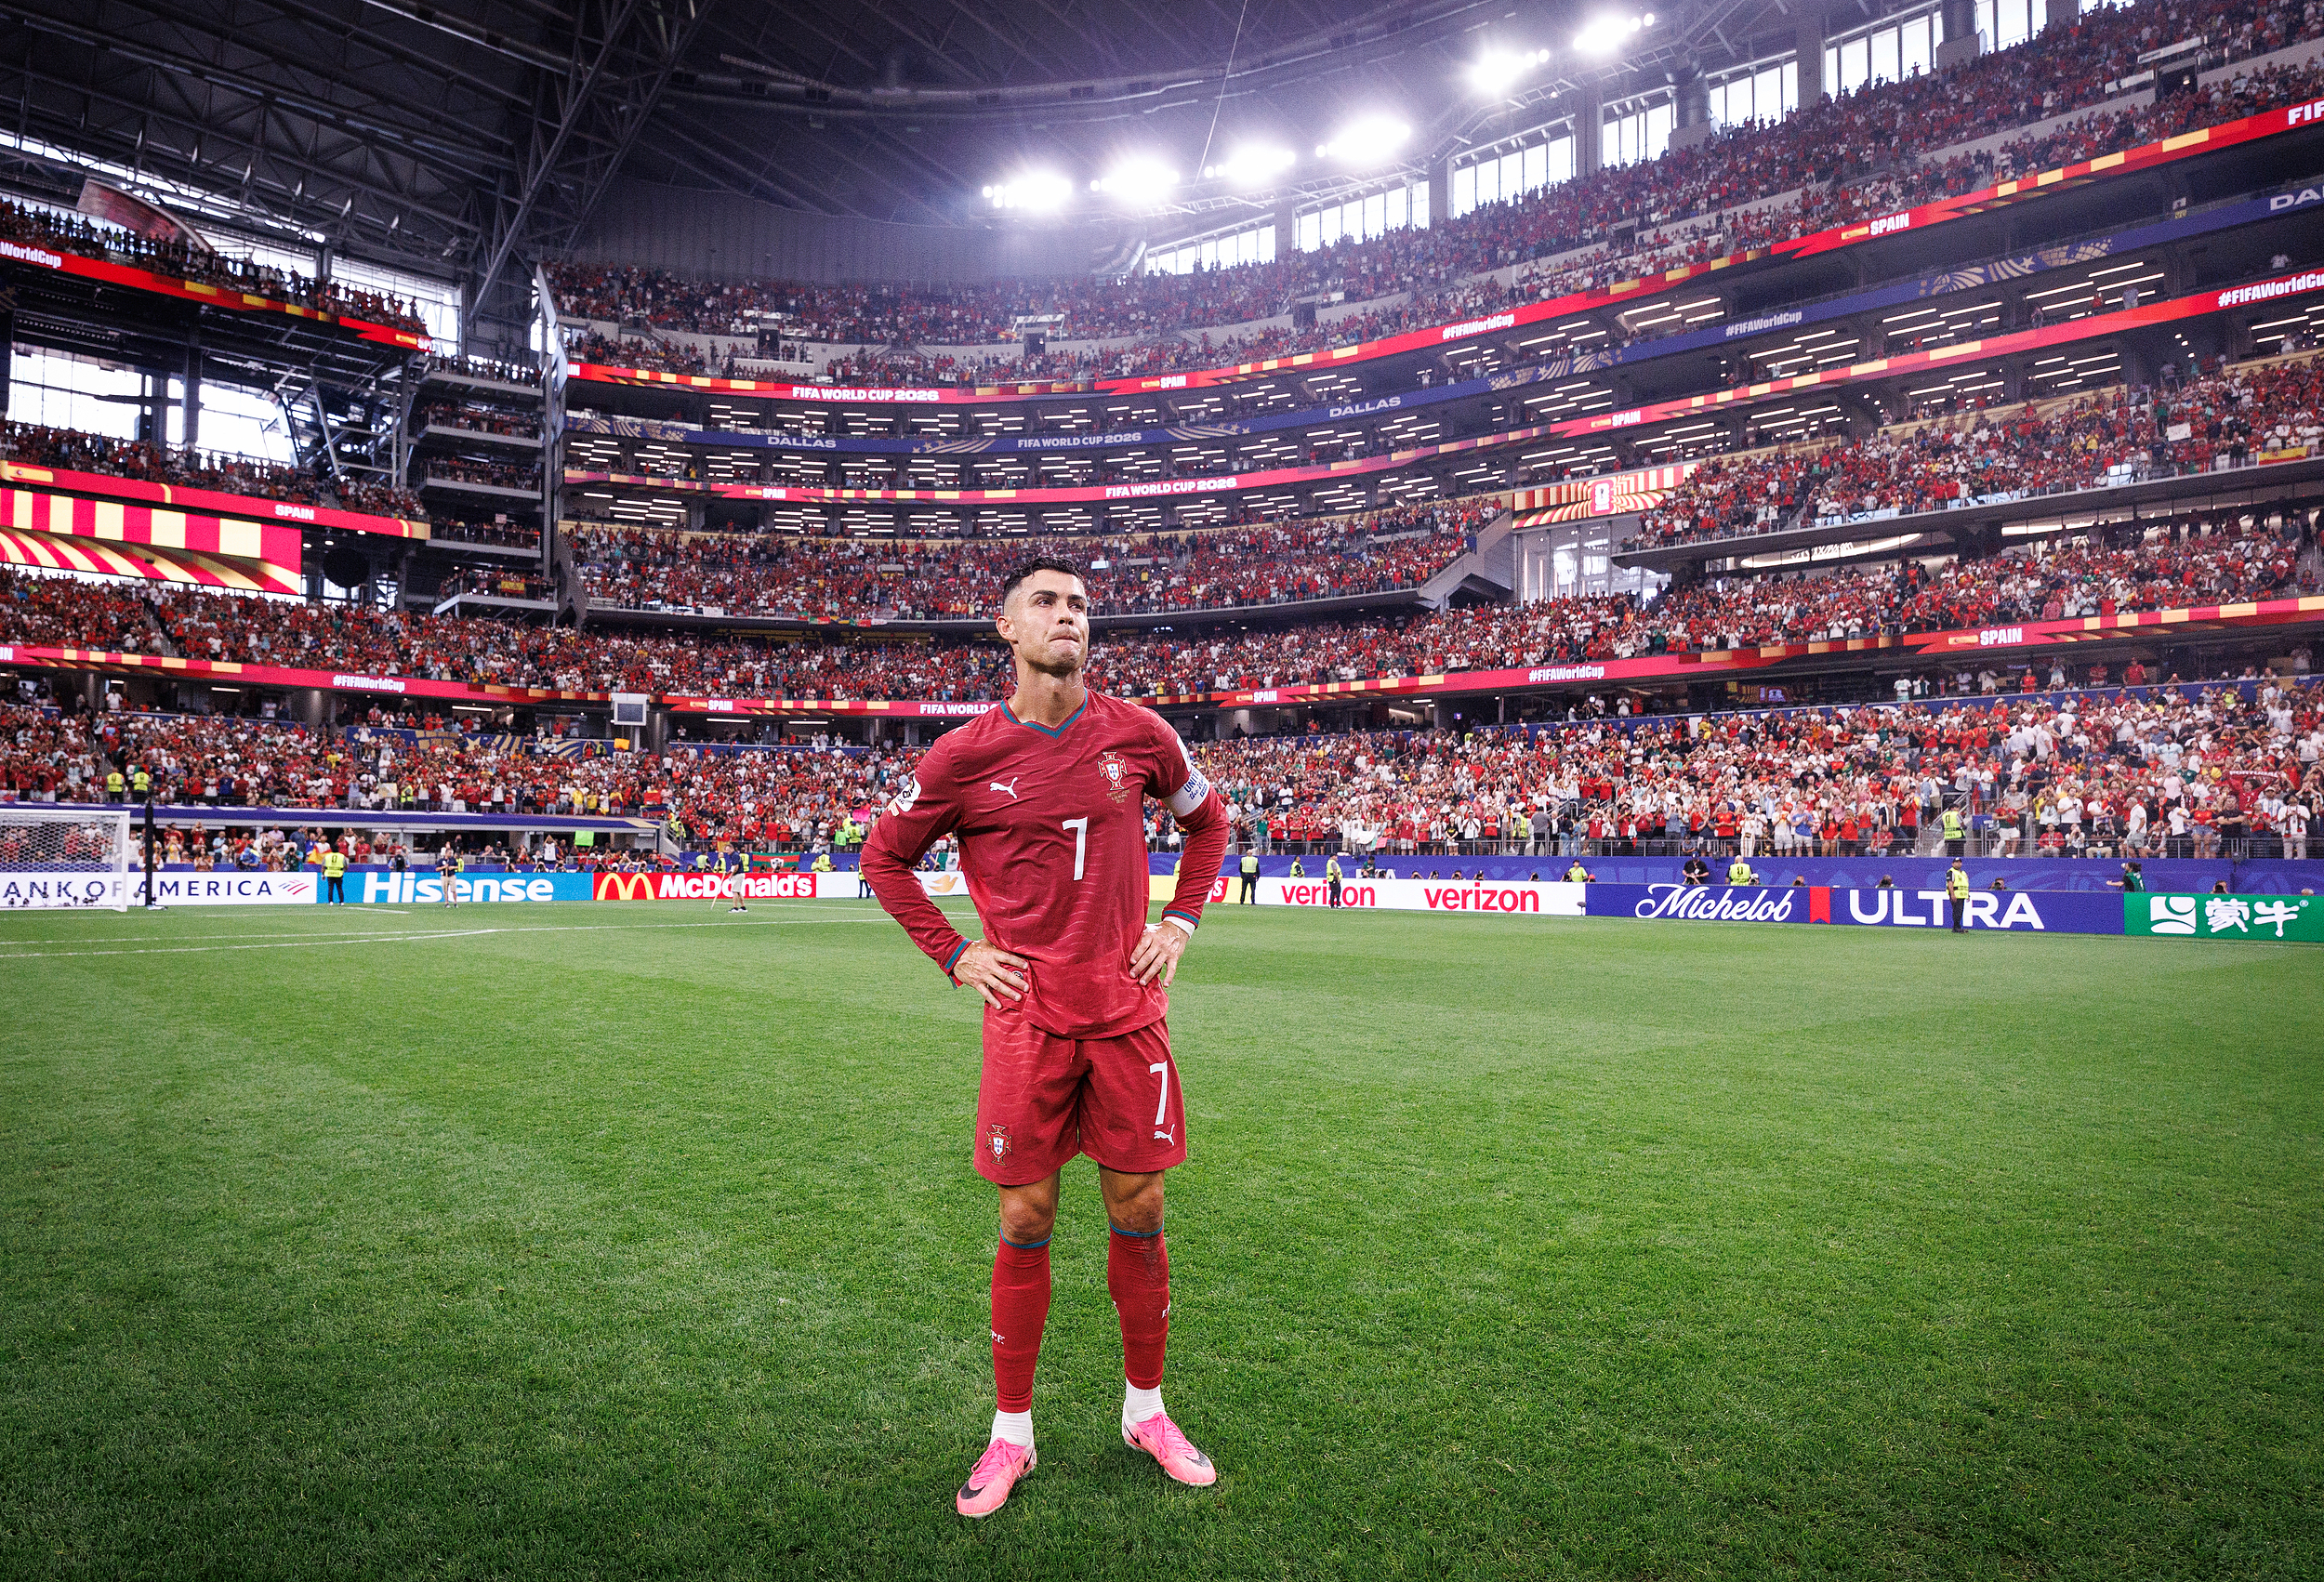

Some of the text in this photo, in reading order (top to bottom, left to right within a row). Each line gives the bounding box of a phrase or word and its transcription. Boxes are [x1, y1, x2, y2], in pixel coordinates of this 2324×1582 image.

[2270, 186, 2324, 211] DA
[1870, 212, 1909, 235] SPAIN
[1442, 313, 1515, 340] #FIFAWorldCup
[1725, 311, 1802, 337] #FIFAWorldCup
[1160, 375, 1186, 389] SPAIN
[792, 386, 940, 402] FIFA WORLD CUP 2026
[1329, 396, 1401, 418] DALLAS
[1612, 410, 1641, 427] SPAIN
[767, 436, 837, 448] DALLAS
[1018, 432, 1142, 448] FIFA WORLD CUP 2026
[762, 488, 786, 499] SPAIN
[1105, 477, 1237, 498] FIFA WORLD CUP 2026
[274, 504, 315, 521] SPAIN
[1980, 627, 2023, 646] SPAIN
[1528, 665, 1604, 682] #FIFAWorldCup
[333, 674, 405, 693] #FIFAWorldCup
[707, 699, 733, 711] SPAIN
[1253, 690, 1277, 703] SPAIN
[919, 704, 945, 715] FIFA
[946, 704, 989, 715] WORLD
[1062, 816, 1088, 881] 7
[86, 880, 122, 898] OF
[1281, 879, 1376, 907] verion
[1424, 882, 1539, 913] verizon
[1635, 884, 1795, 922] Michelob
[1849, 889, 2045, 929] ULTRA
[2205, 897, 2301, 937] 蒙牛
[1149, 1061, 1169, 1126] 7
